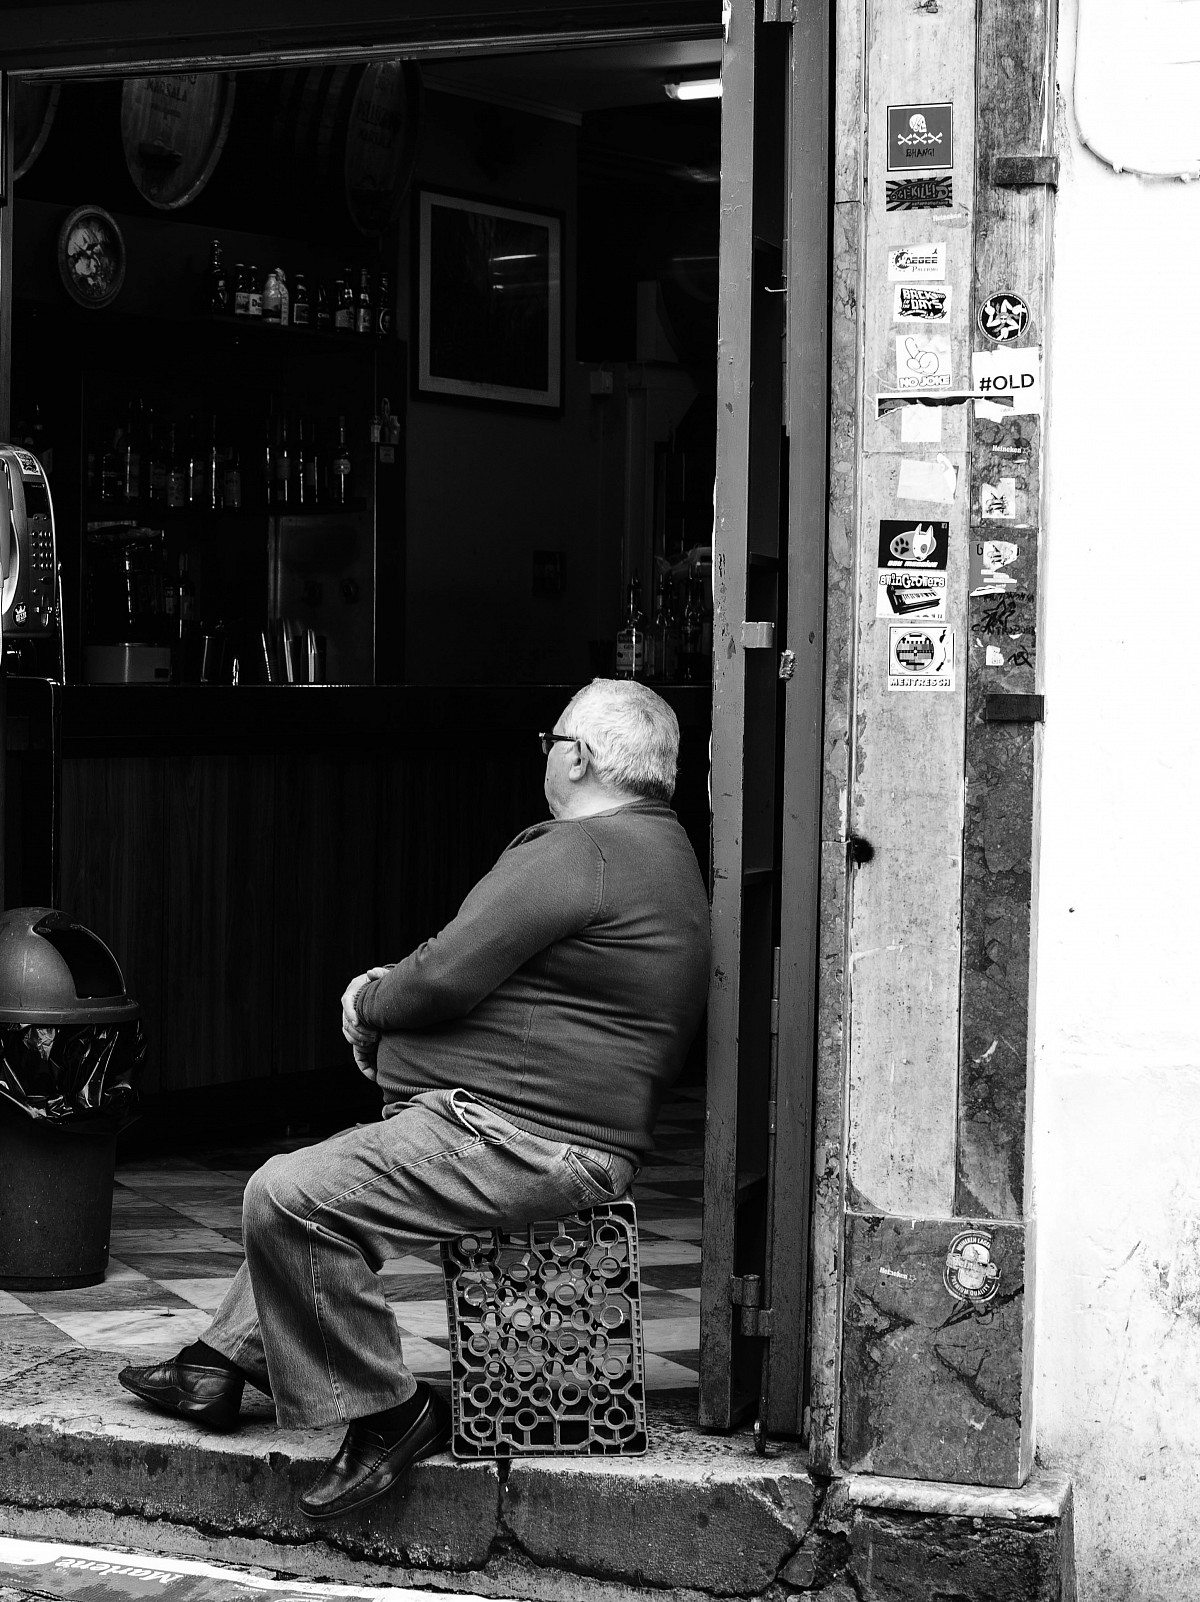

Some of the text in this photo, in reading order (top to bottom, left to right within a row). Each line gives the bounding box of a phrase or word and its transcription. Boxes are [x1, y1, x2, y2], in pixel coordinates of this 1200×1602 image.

[905, 149, 936, 158] BHANGI
[907, 256, 939, 264] AEGEE
[899, 374, 951, 388] NO JOKE
[979, 374, 1036, 392] #OLD
[889, 678, 951, 688] MENTRESCH
[977, 1237, 991, 1249] LAGE
[53, 1556, 186, 1586] Marlene
